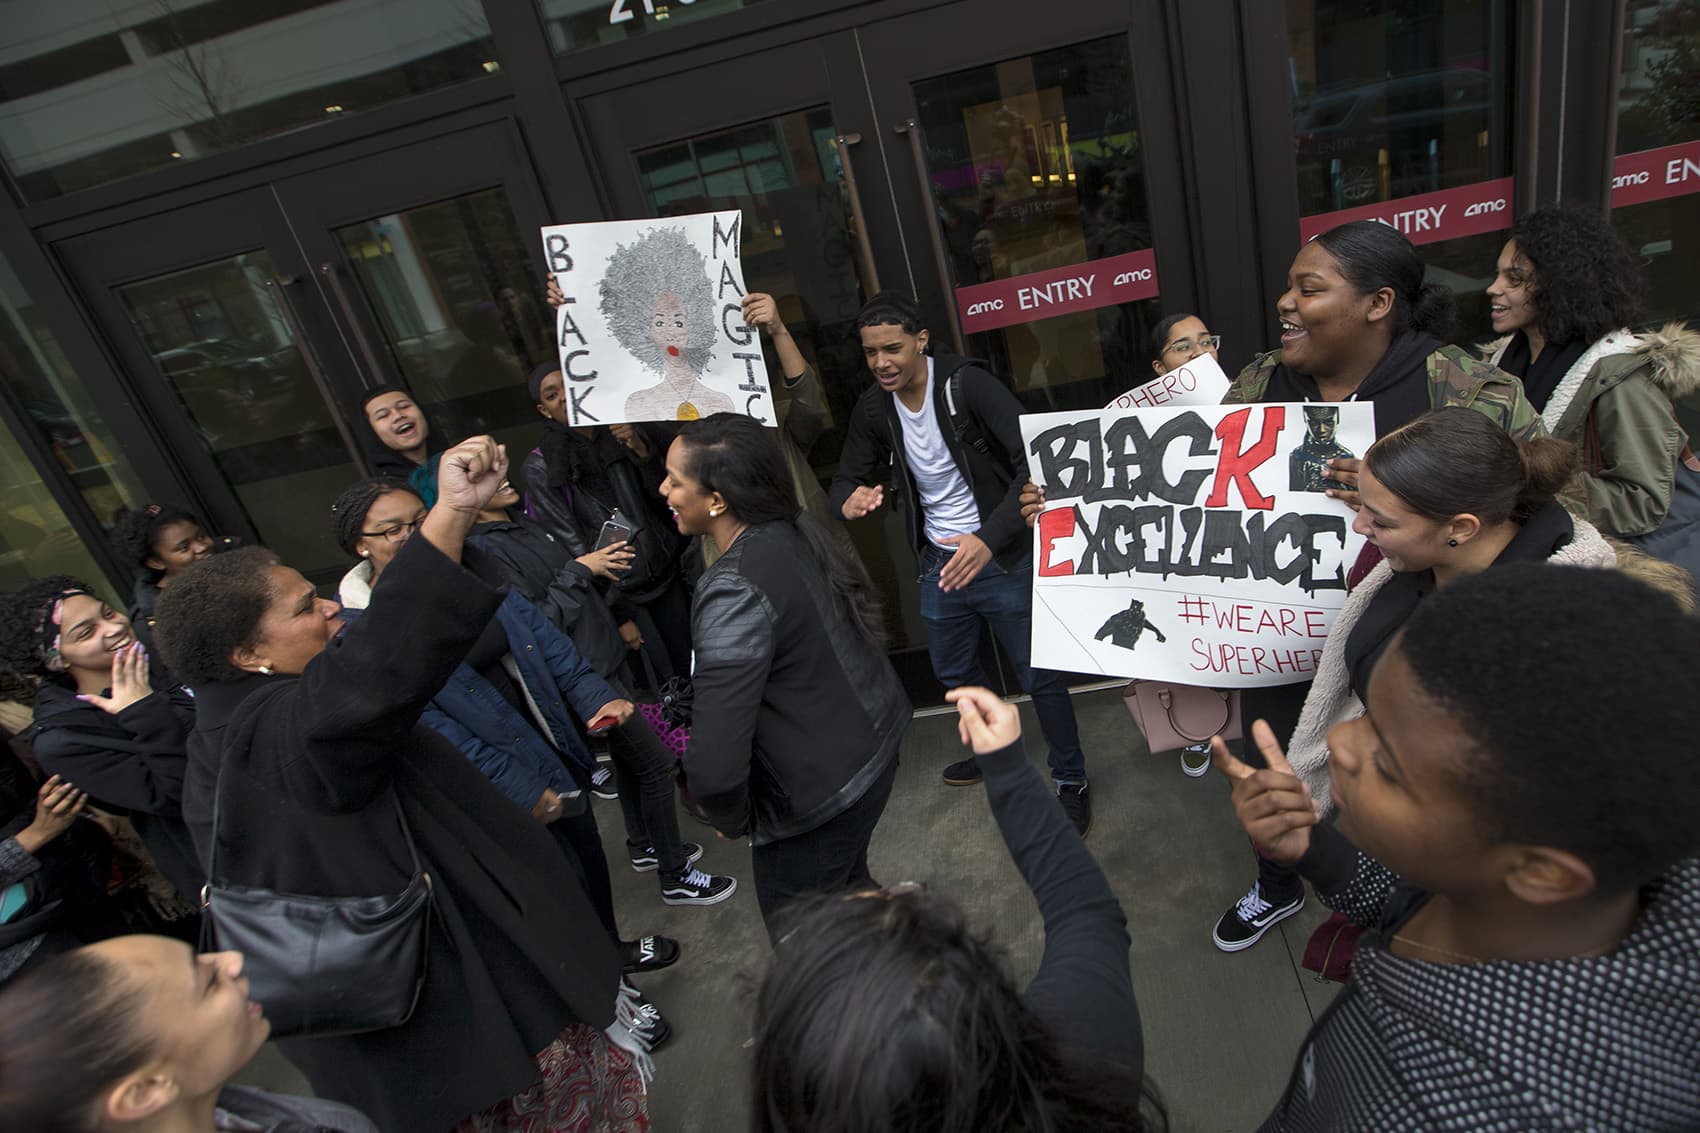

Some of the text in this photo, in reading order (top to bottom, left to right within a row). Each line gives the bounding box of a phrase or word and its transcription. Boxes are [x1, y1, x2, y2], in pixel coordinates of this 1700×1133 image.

[1365, 199, 1506, 234] NTRY amc
[967, 268, 1152, 316] amc ENTRY amc
[712, 214, 768, 423] MAGIC
[1107, 367, 1197, 409] PHERO
[1030, 406, 1286, 511] BLACK
